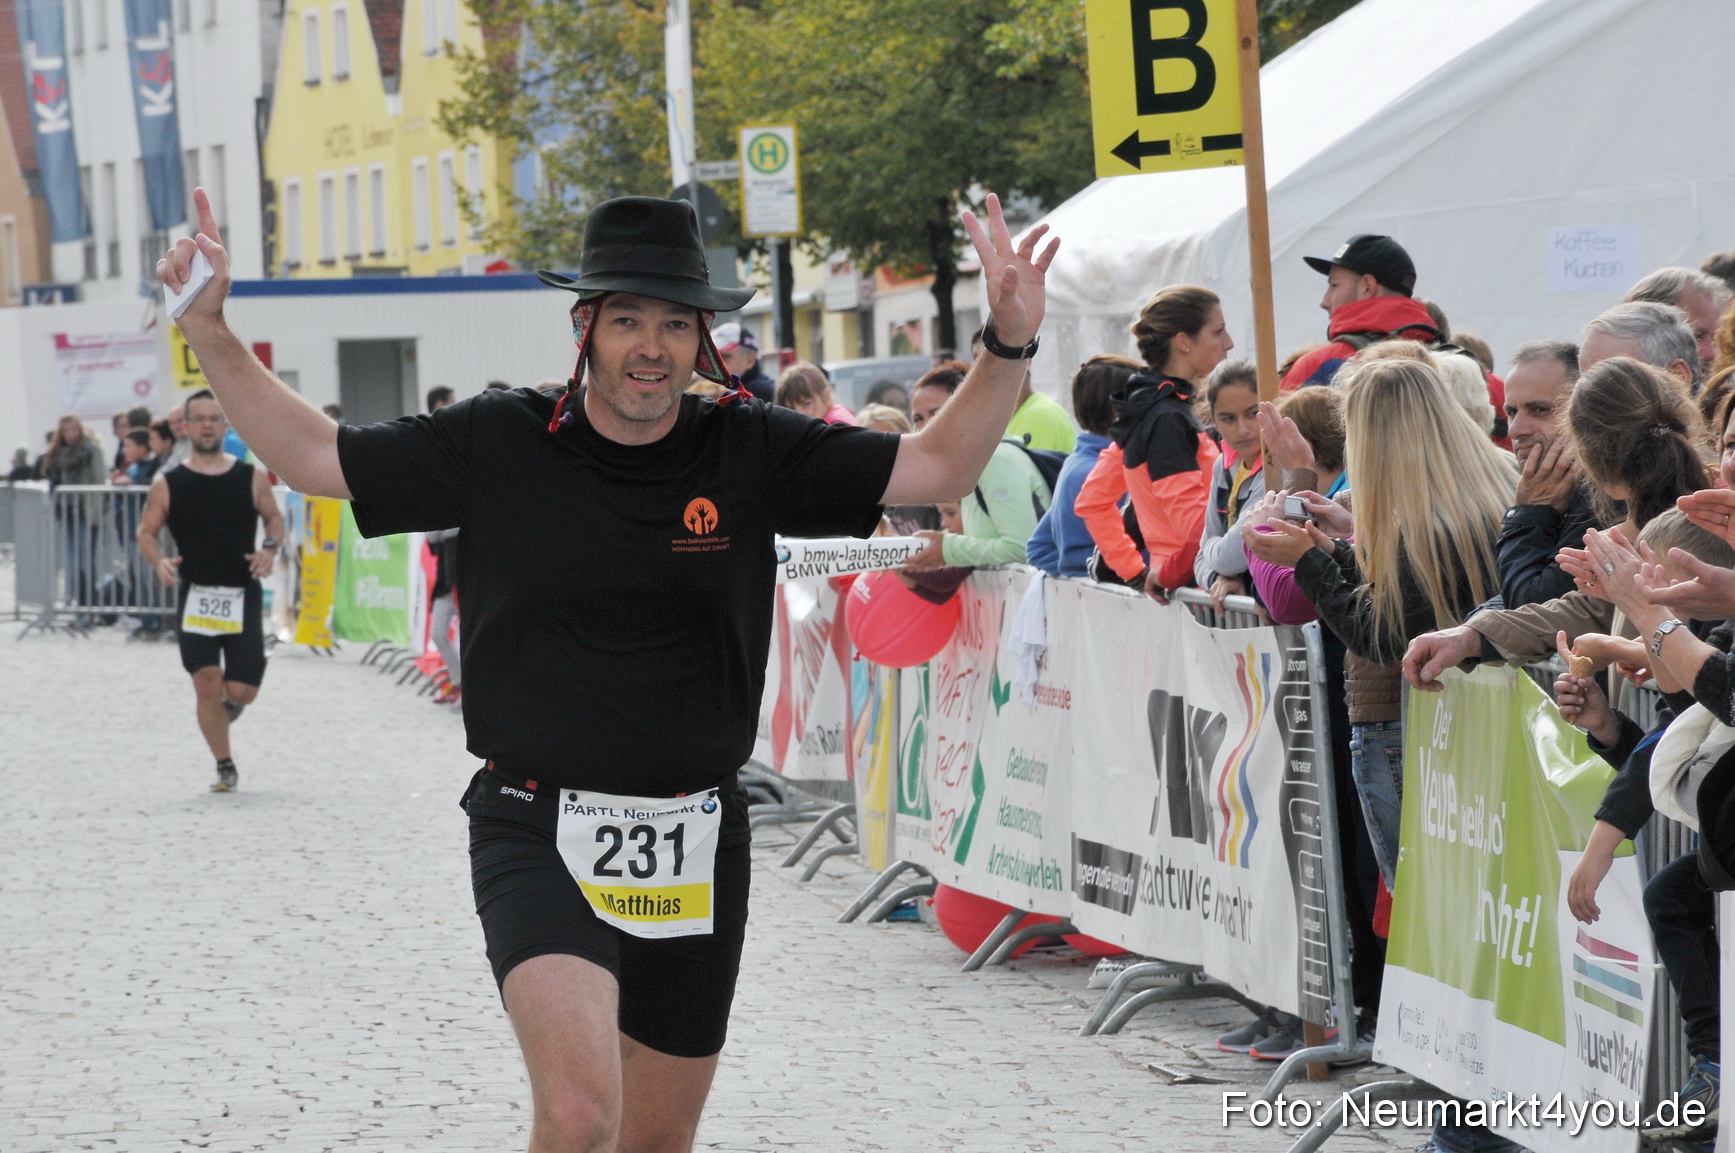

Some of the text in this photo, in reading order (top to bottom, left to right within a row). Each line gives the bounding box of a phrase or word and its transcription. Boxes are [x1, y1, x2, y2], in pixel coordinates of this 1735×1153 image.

[134, 19, 173, 117] K&L
[1130, 0, 1216, 117] B
[785, 563, 830, 580] BMW
[198, 597, 232, 618] 528
[1431, 698, 1452, 750] Der
[500, 786, 534, 802] SPIRO
[563, 803, 620, 818] PARTL
[593, 822, 685, 880] 231
[600, 892, 682, 917] Matthias
